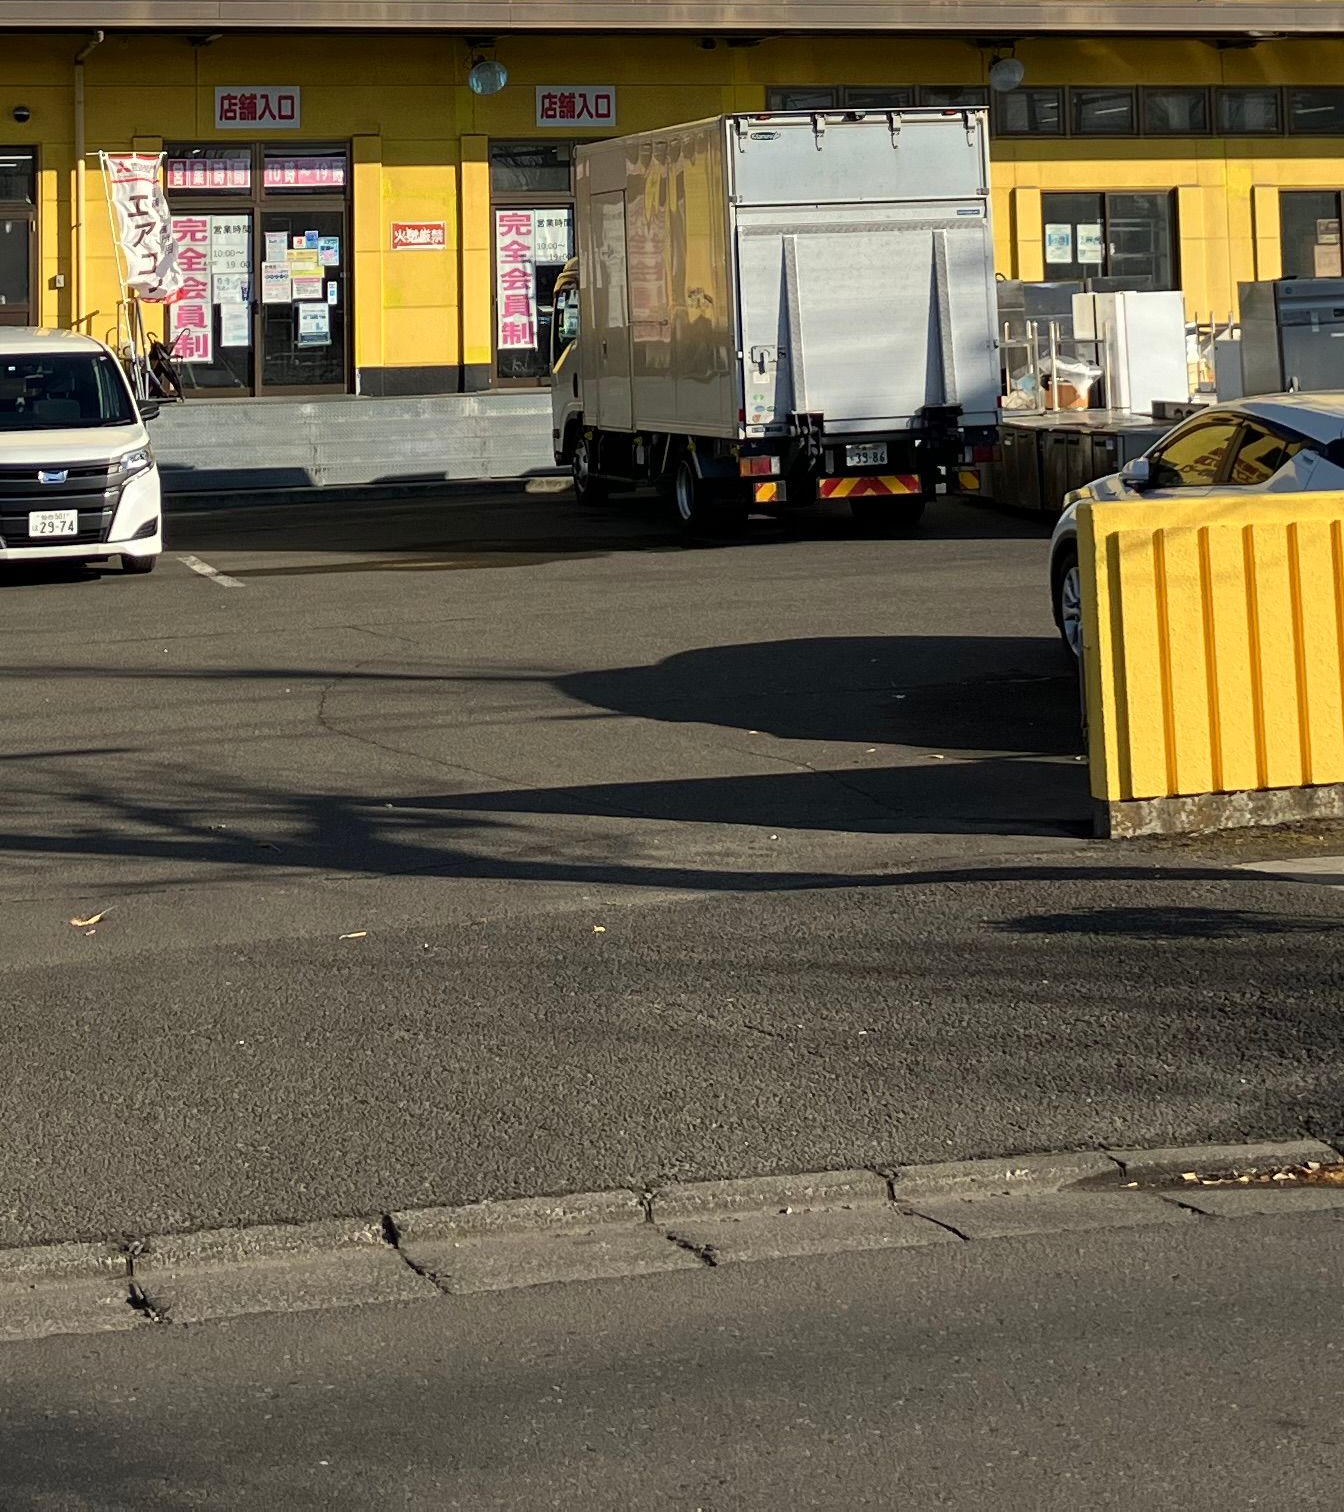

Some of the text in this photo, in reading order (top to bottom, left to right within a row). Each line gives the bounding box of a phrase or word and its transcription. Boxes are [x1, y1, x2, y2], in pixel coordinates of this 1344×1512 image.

[219, 93, 296, 122] 店舗入口
[540, 92, 611, 120] 店舗入口
[172, 217, 209, 359] 完全会員制
[498, 212, 535, 346] 完全会員制
[39, 520, 75, 534] 29-74
